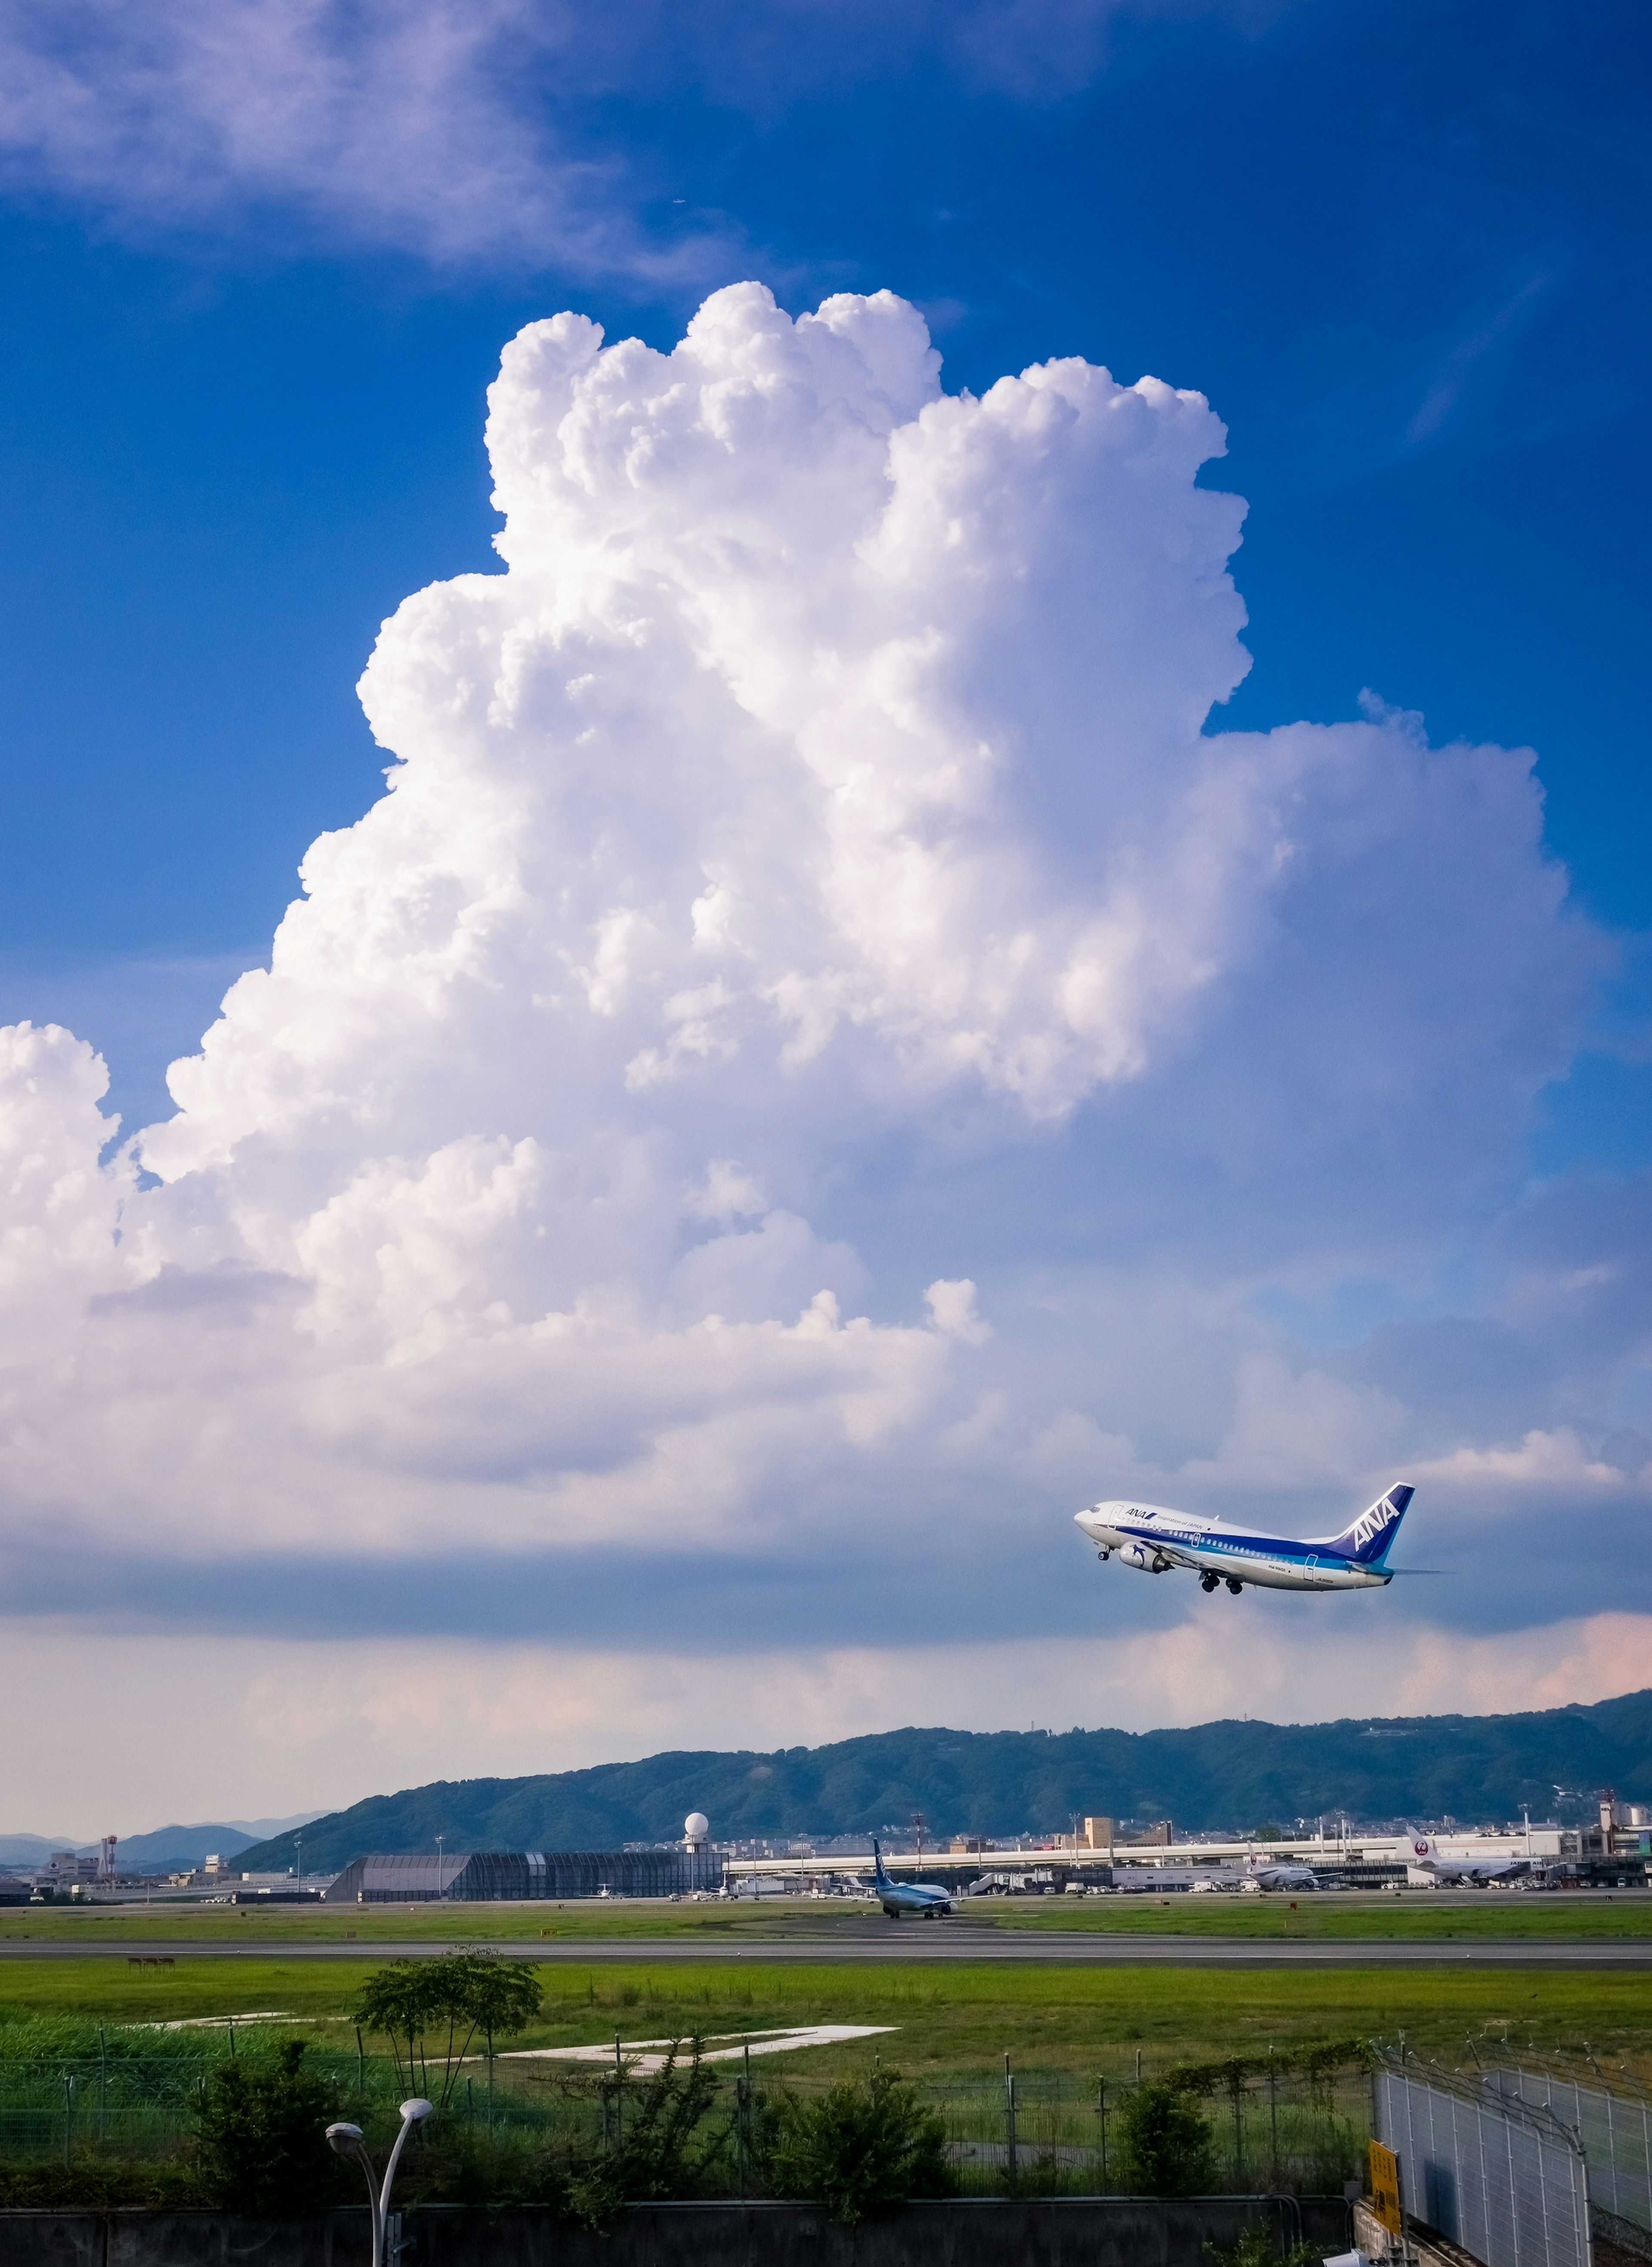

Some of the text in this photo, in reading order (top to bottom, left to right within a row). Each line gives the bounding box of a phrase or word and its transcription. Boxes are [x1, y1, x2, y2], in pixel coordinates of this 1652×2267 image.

[1125, 1508, 1147, 1519] ANA
[1157, 1515, 1181, 1524] Inspiration
[1354, 1497, 1399, 1552] ANA
